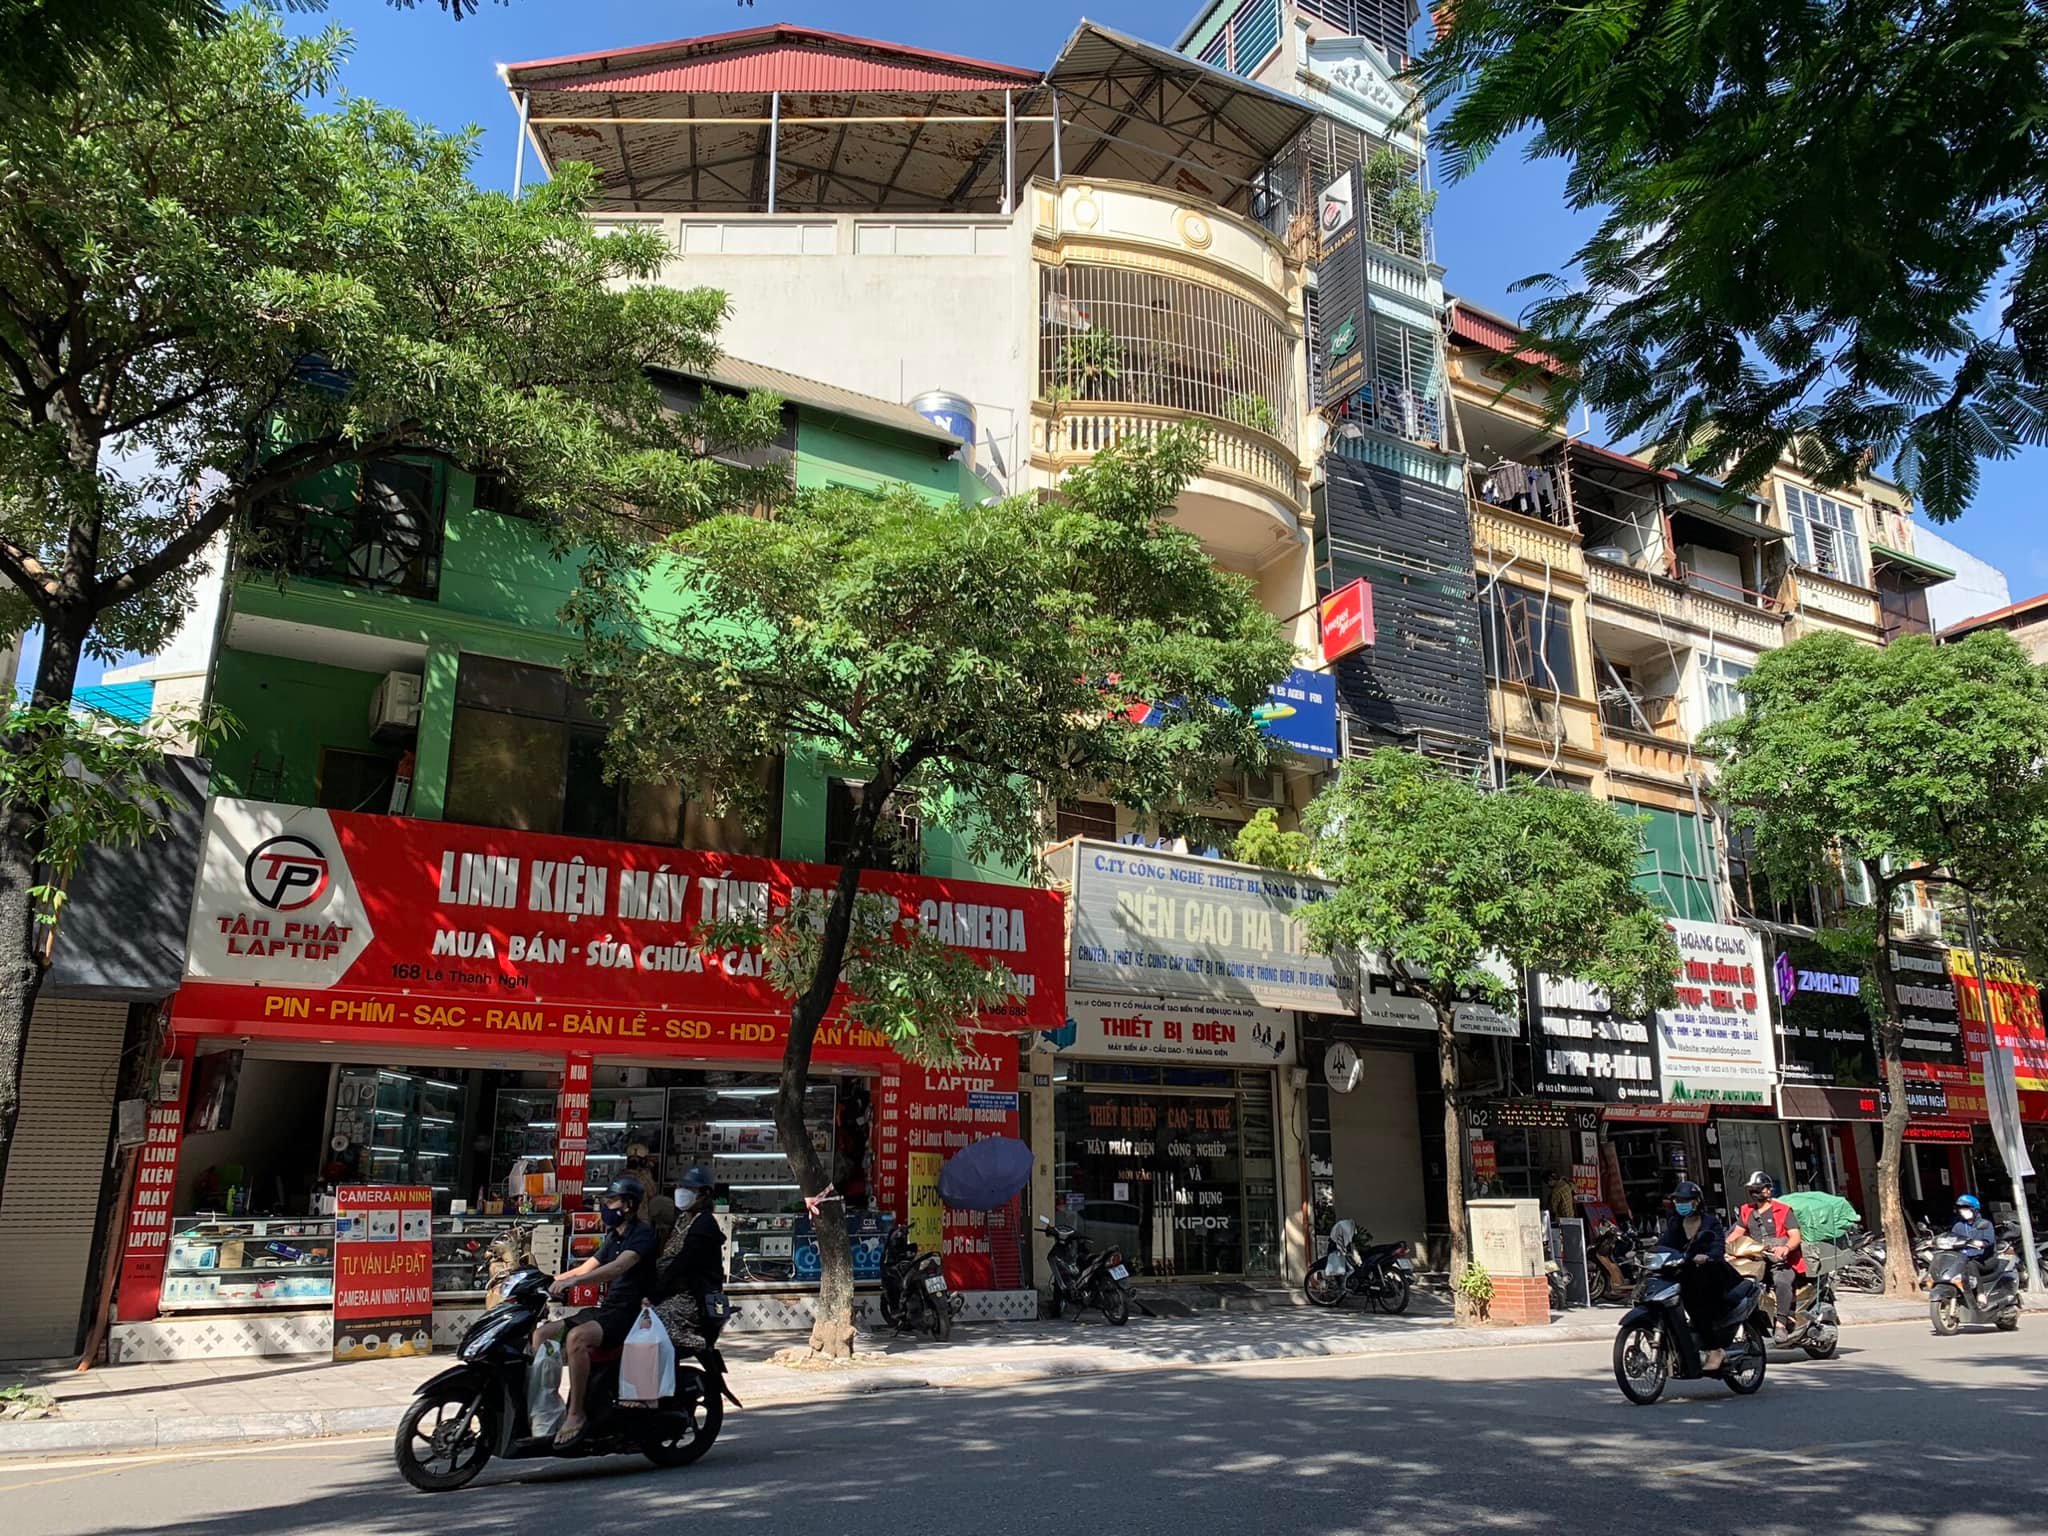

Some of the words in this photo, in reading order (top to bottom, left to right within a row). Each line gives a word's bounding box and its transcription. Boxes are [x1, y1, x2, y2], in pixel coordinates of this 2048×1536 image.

[1094, 854, 1126, 875] C.TY
[1207, 873, 1244, 892] THIẾT
[438, 850, 520, 909] LINH
[528, 855, 608, 923] KIỆN
[618, 864, 689, 924] MÁY
[698, 870, 769, 929] TÍNH
[285, 920, 353, 943] PHÁT
[919, 899, 1026, 951] CAMERA
[1184, 897, 1233, 947] CAO
[1241, 907, 1273, 960] HẠ
[228, 937, 339, 961] LAPTOP
[431, 930, 496, 959] MUA
[508, 931, 566, 964] BÁN
[586, 934, 634, 969] SỬA
[640, 941, 704, 974] CHỮA
[392, 964, 421, 981] 168
[449, 971, 492, 984] Thanh
[1798, 970, 1859, 997] ZMAC.VN
[265, 995, 310, 1018] PIN
[330, 996, 395, 1023] PHÍM
[413, 1005, 466, 1030] SẠC
[485, 1009, 543, 1032] RAM
[563, 1009, 613, 1035] BẢN
[618, 1011, 648, 1037] LỀ
[665, 1019, 712, 1039] SSD
[730, 1023, 776, 1042] HDD
[1100, 1013, 1153, 1039] THIẾT
[1164, 1021, 1181, 1043] BỊ
[1192, 1021, 1236, 1045] ĐIỆN
[1108, 1044, 1122, 1052] MÁY
[570, 1064, 587, 1080] MUA
[960, 1053, 1003, 1072] PHÁT
[925, 1075, 994, 1092] LAPTOP
[564, 1093, 589, 1109] IPHONE
[150, 1110, 181, 1124] MUA
[938, 1104, 948, 1121] PC
[950, 1104, 973, 1123] Laptop
[1089, 1101, 1119, 1128] THIẾT
[1120, 1104, 1131, 1132] BỊ
[1133, 1102, 1157, 1132] ĐIỆN
[1168, 1106, 1188, 1130] CAO
[1195, 1107, 1210, 1132] HẠ
[1212, 1103, 1231, 1130] THẾ
[1469, 1110, 1488, 1127] 162
[1579, 1113, 1597, 1129] 162
[147, 1125, 176, 1143] BÁN
[565, 1121, 583, 1137] IPAD
[143, 1147, 176, 1162] LINH
[1087, 1137, 1107, 1155] MÁY
[1108, 1138, 1133, 1156] PHÁT
[560, 1151, 584, 1167] LAPTOP
[140, 1166, 173, 1187] KIỆN
[1188, 1164, 1202, 1182] VÀ
[138, 1188, 169, 1206] MÁY
[339, 1190, 391, 1203] CAMERA
[393, 1191, 407, 1203] AN
[409, 1191, 432, 1203] NINH
[1199, 1191, 1223, 1208] DỤNG
[132, 1208, 166, 1226] TÍNH
[1175, 1216, 1229, 1230] KIPOR
[128, 1231, 166, 1248] LAPTOP
[342, 1256, 358, 1276] TƯ
[338, 1290, 369, 1307] CAMERA
[370, 1289, 381, 1305] AN
[382, 1288, 400, 1305] NINH
[401, 1285, 415, 1308] TẬN
